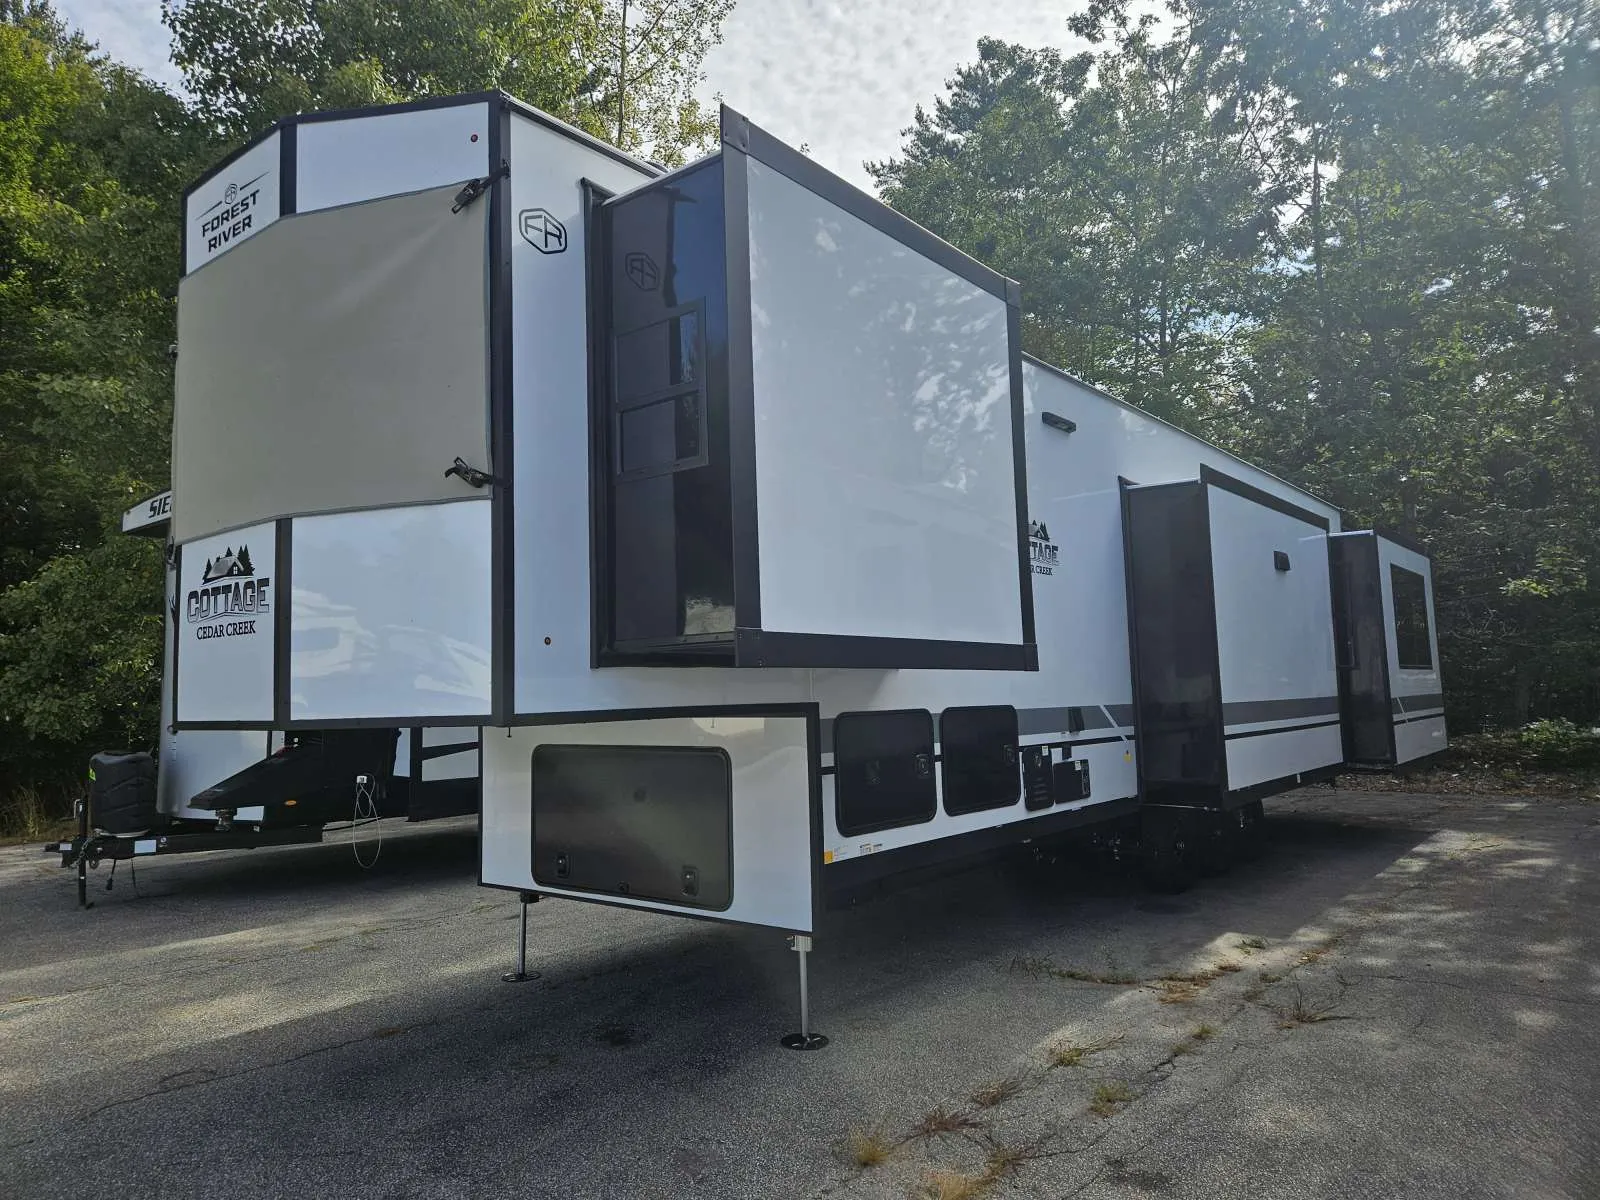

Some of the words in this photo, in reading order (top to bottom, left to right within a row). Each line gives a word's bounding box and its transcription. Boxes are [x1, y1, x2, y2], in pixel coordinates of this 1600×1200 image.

[202, 189, 260, 238] FOREST
[208, 214, 252, 253] RIVER
[148, 495, 172, 518] SIE
[1030, 541, 1059, 565] TAGE
[187, 577, 270, 623] COTTAGE
[197, 624, 225, 640] CEDAR
[226, 620, 256, 637] CREEK
